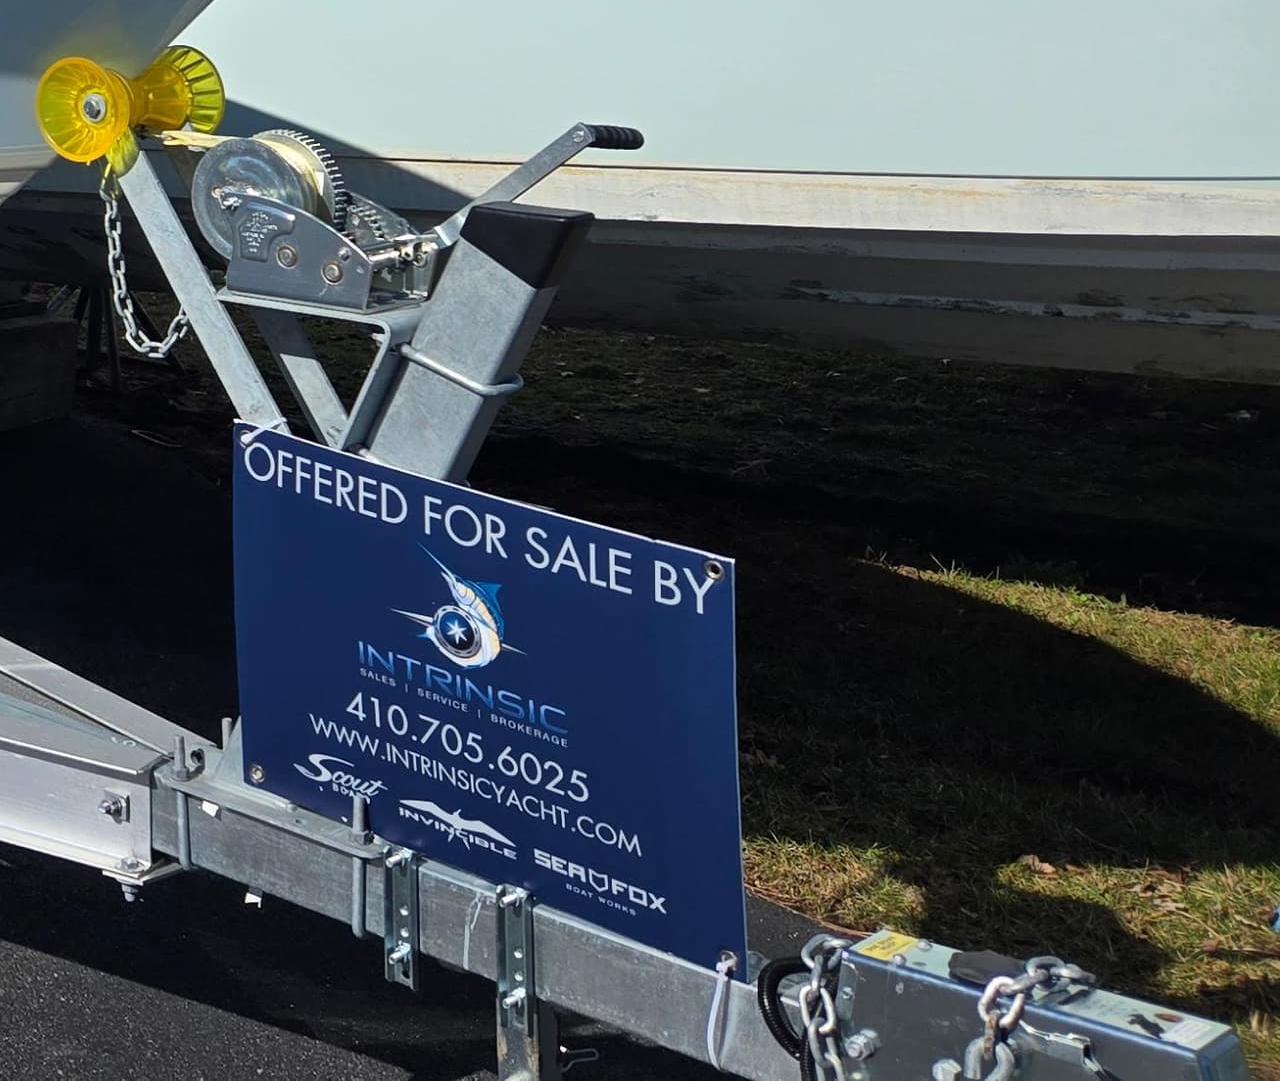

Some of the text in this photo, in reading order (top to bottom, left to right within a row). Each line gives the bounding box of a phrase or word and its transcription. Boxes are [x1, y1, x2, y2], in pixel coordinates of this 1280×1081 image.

[243, 441, 714, 616] OFFERED FOR SALE BY
[357, 640, 569, 734] INTRINSIC
[359, 667, 569, 749] SALES SERVICE BROKERAGE
[293, 752, 389, 798] Scout
[308, 713, 643, 857] WWW.INTRINSICYACHT.COM
[345, 692, 590, 803] 410.705.6025
[398, 806, 518, 861] INVINCIBLE
[533, 847, 667, 915] SEA FOX
[565, 882, 638, 917] BOAT WORKS
